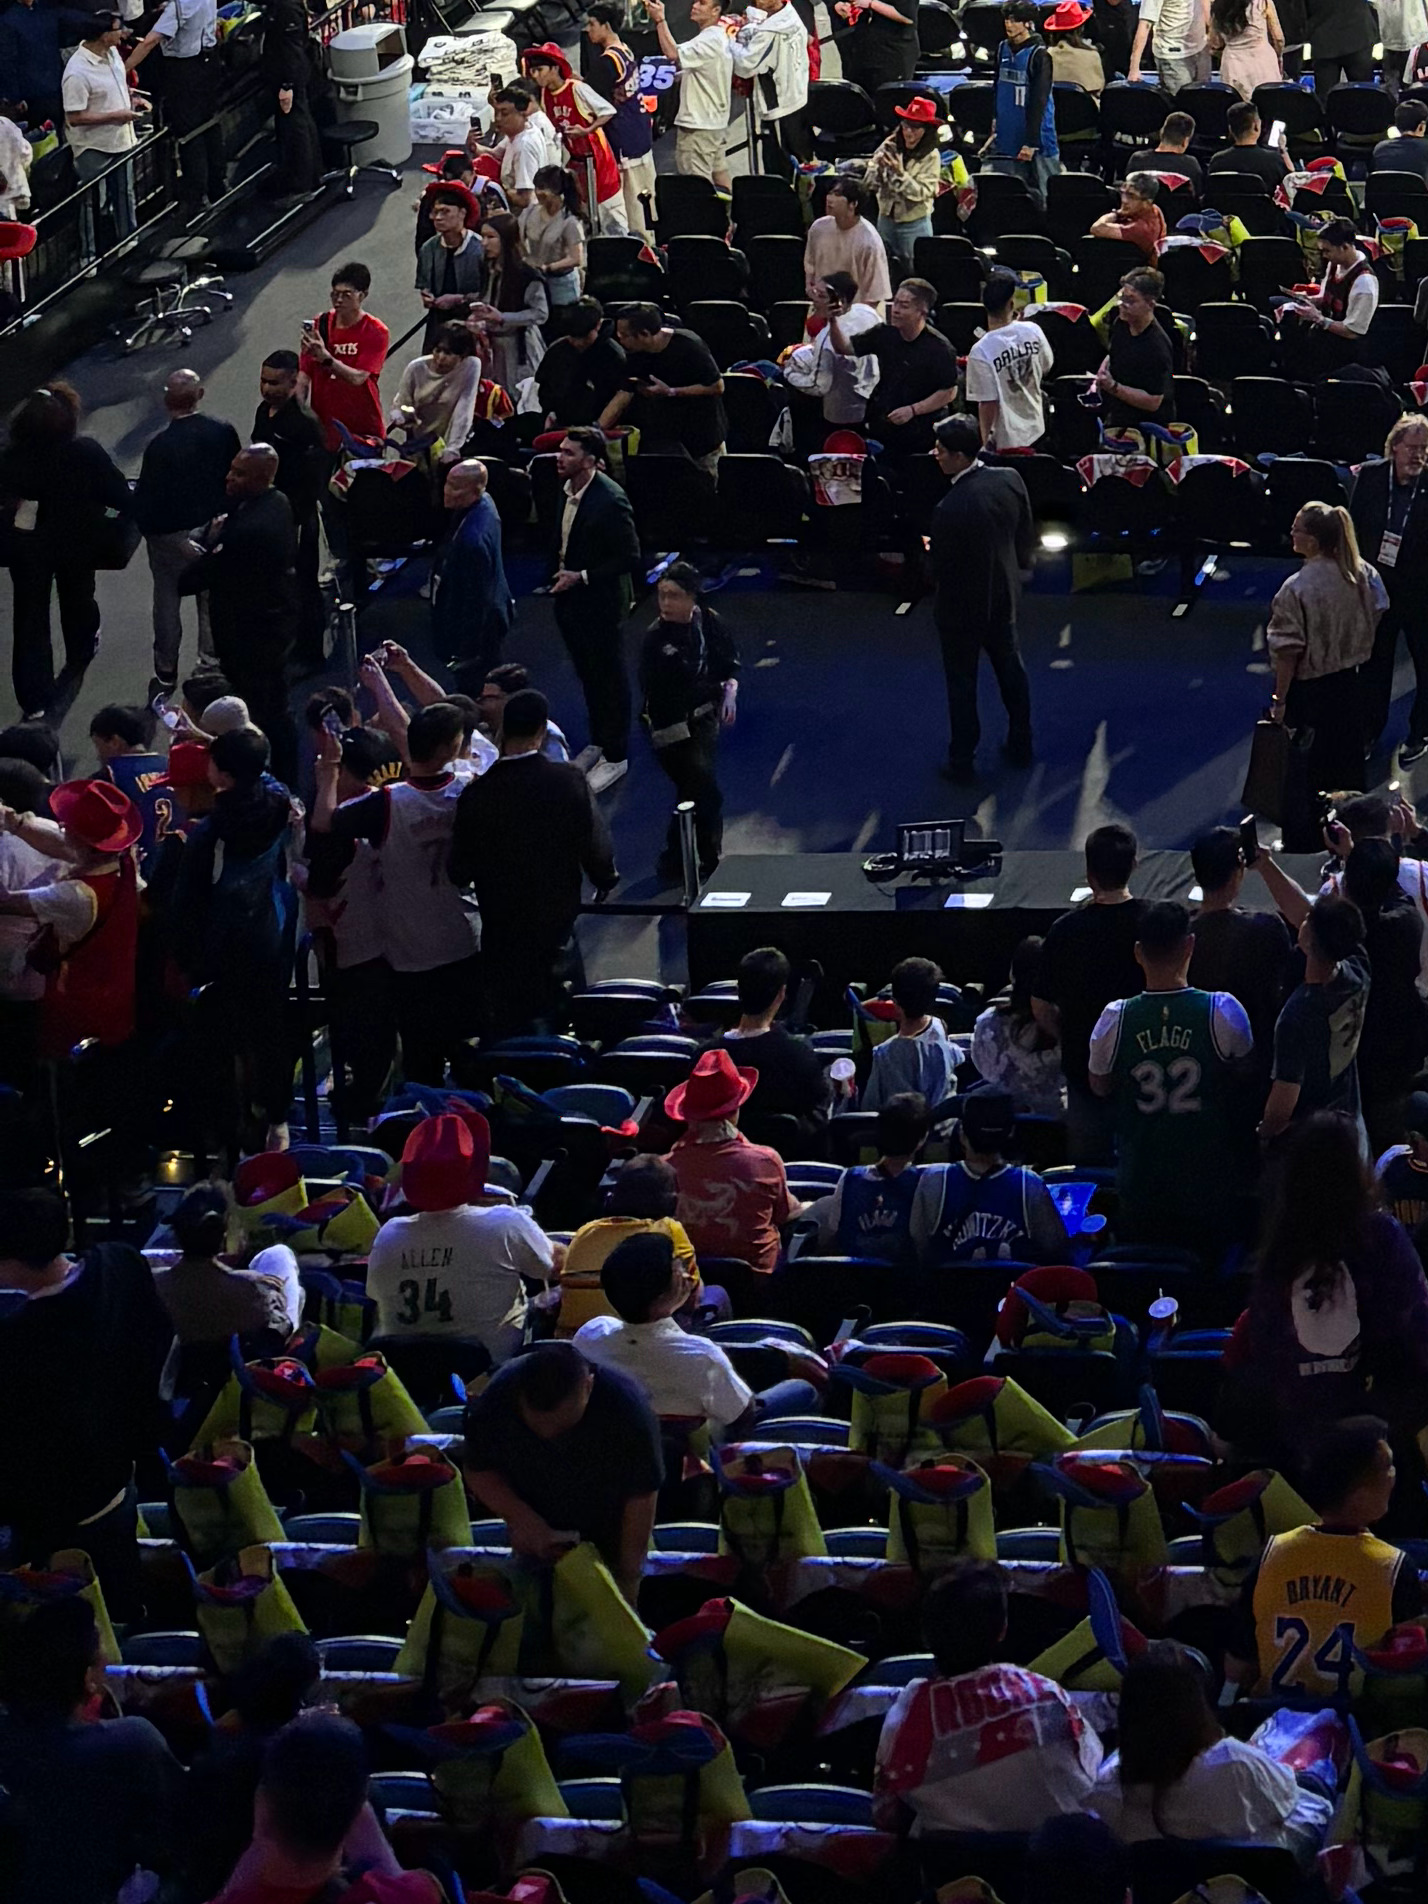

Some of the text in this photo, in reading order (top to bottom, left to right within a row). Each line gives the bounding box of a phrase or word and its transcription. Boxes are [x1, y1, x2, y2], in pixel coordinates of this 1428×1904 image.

[640, 64, 676, 90] 35
[993, 341, 1040, 373] DALLAS
[1136, 1025, 1192, 1053] FLAGG
[1130, 1055, 1202, 1114] 32
[397, 1277, 453, 1324] 34
[1287, 1575, 1357, 1607] BRYANT
[1274, 1617, 1357, 1697] 24
